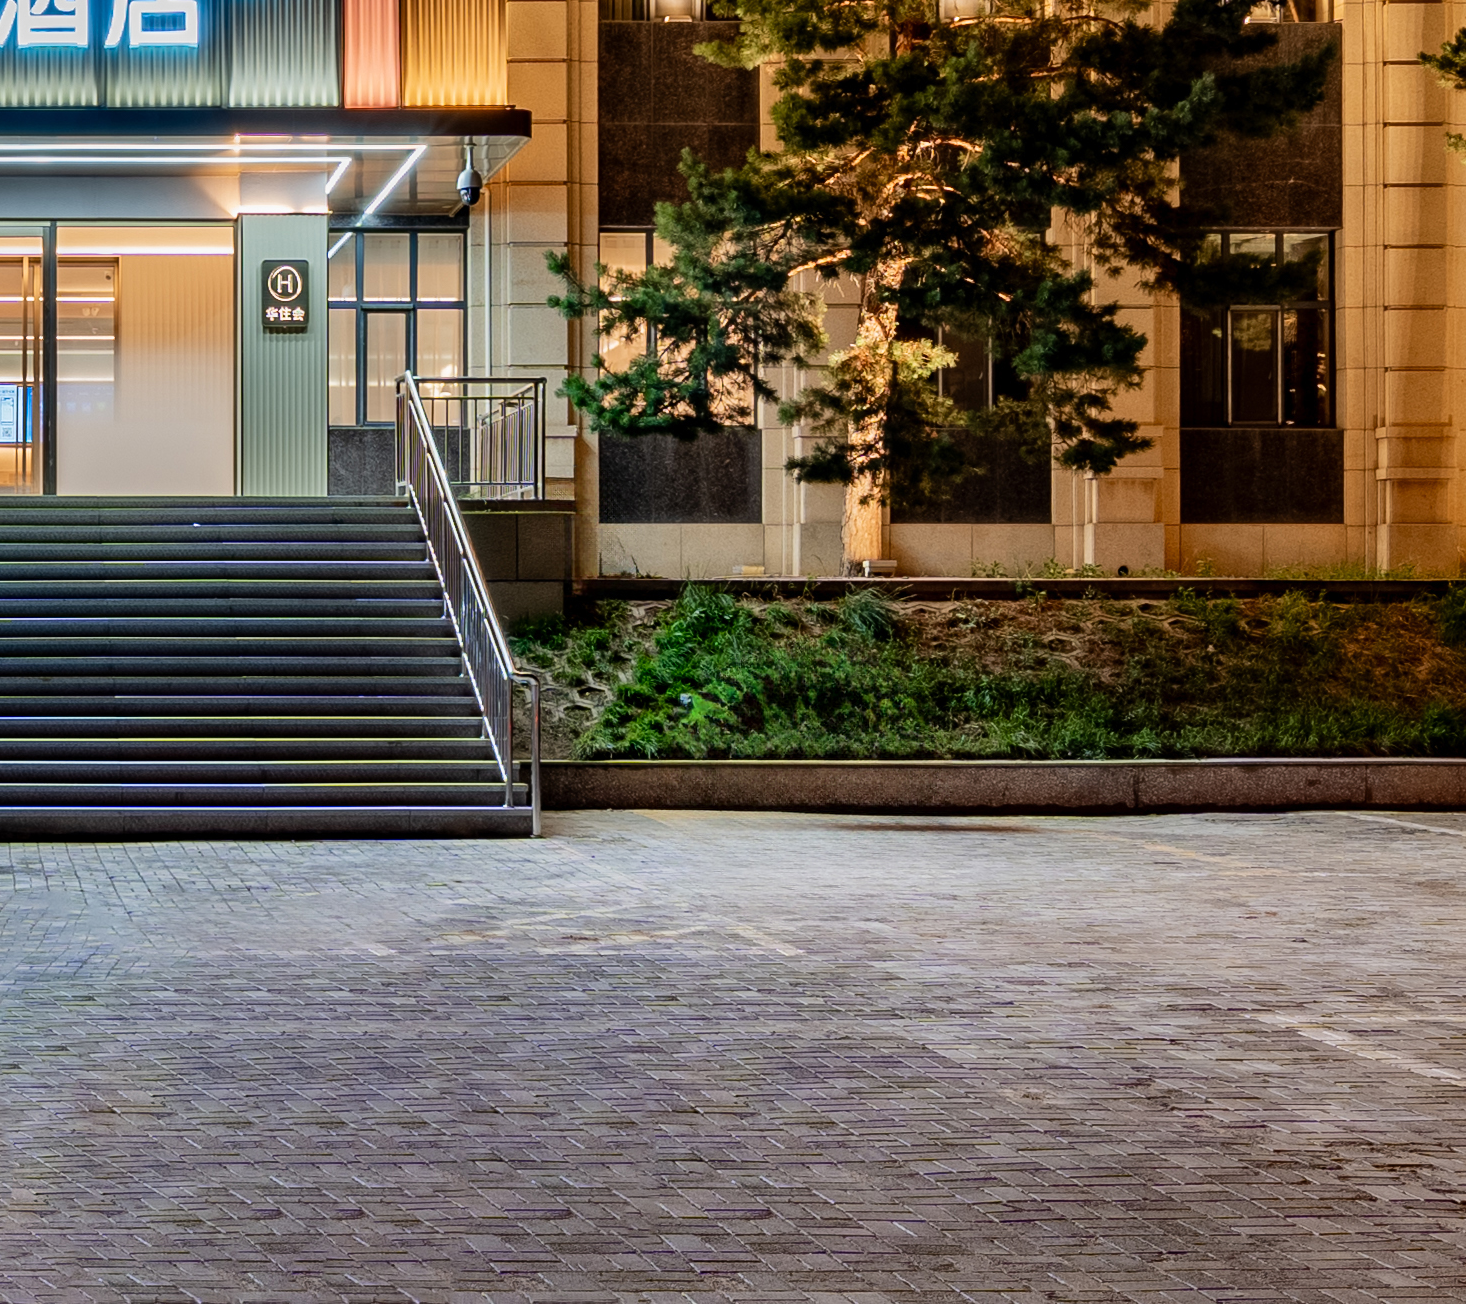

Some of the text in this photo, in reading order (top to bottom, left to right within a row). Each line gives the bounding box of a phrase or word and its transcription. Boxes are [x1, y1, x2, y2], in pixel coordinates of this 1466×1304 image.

[277, 274, 293, 293] H
[265, 306, 305, 321] 华住会
